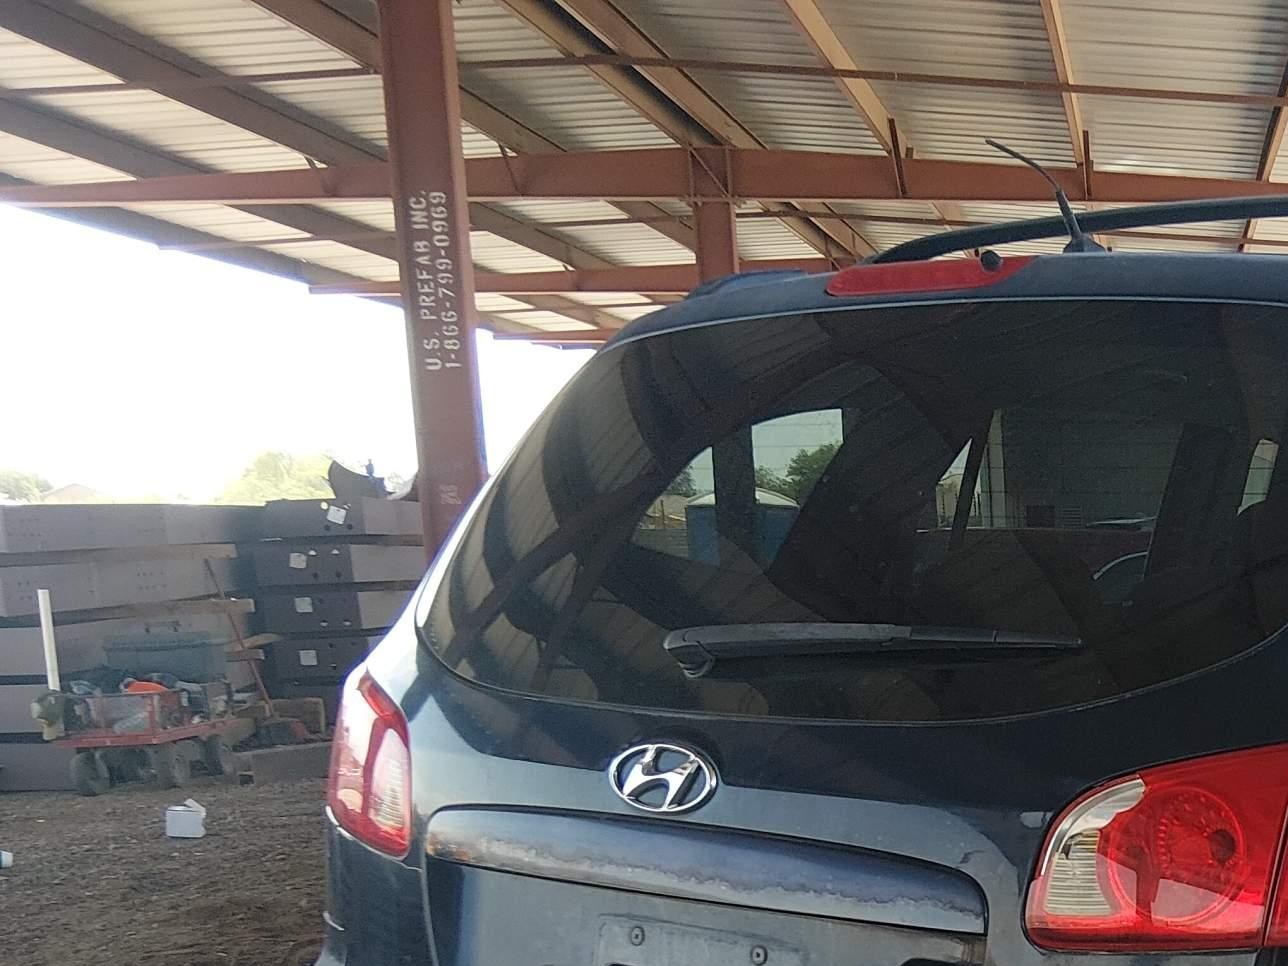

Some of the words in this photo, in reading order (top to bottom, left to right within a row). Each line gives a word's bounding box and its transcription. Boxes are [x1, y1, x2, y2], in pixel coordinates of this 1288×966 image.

[408, 190, 428, 230] INC.
[413, 240, 437, 320] PREFAB
[429, 191, 462, 369] 1-866-799-0969
[424, 331, 442, 370] U.S.
